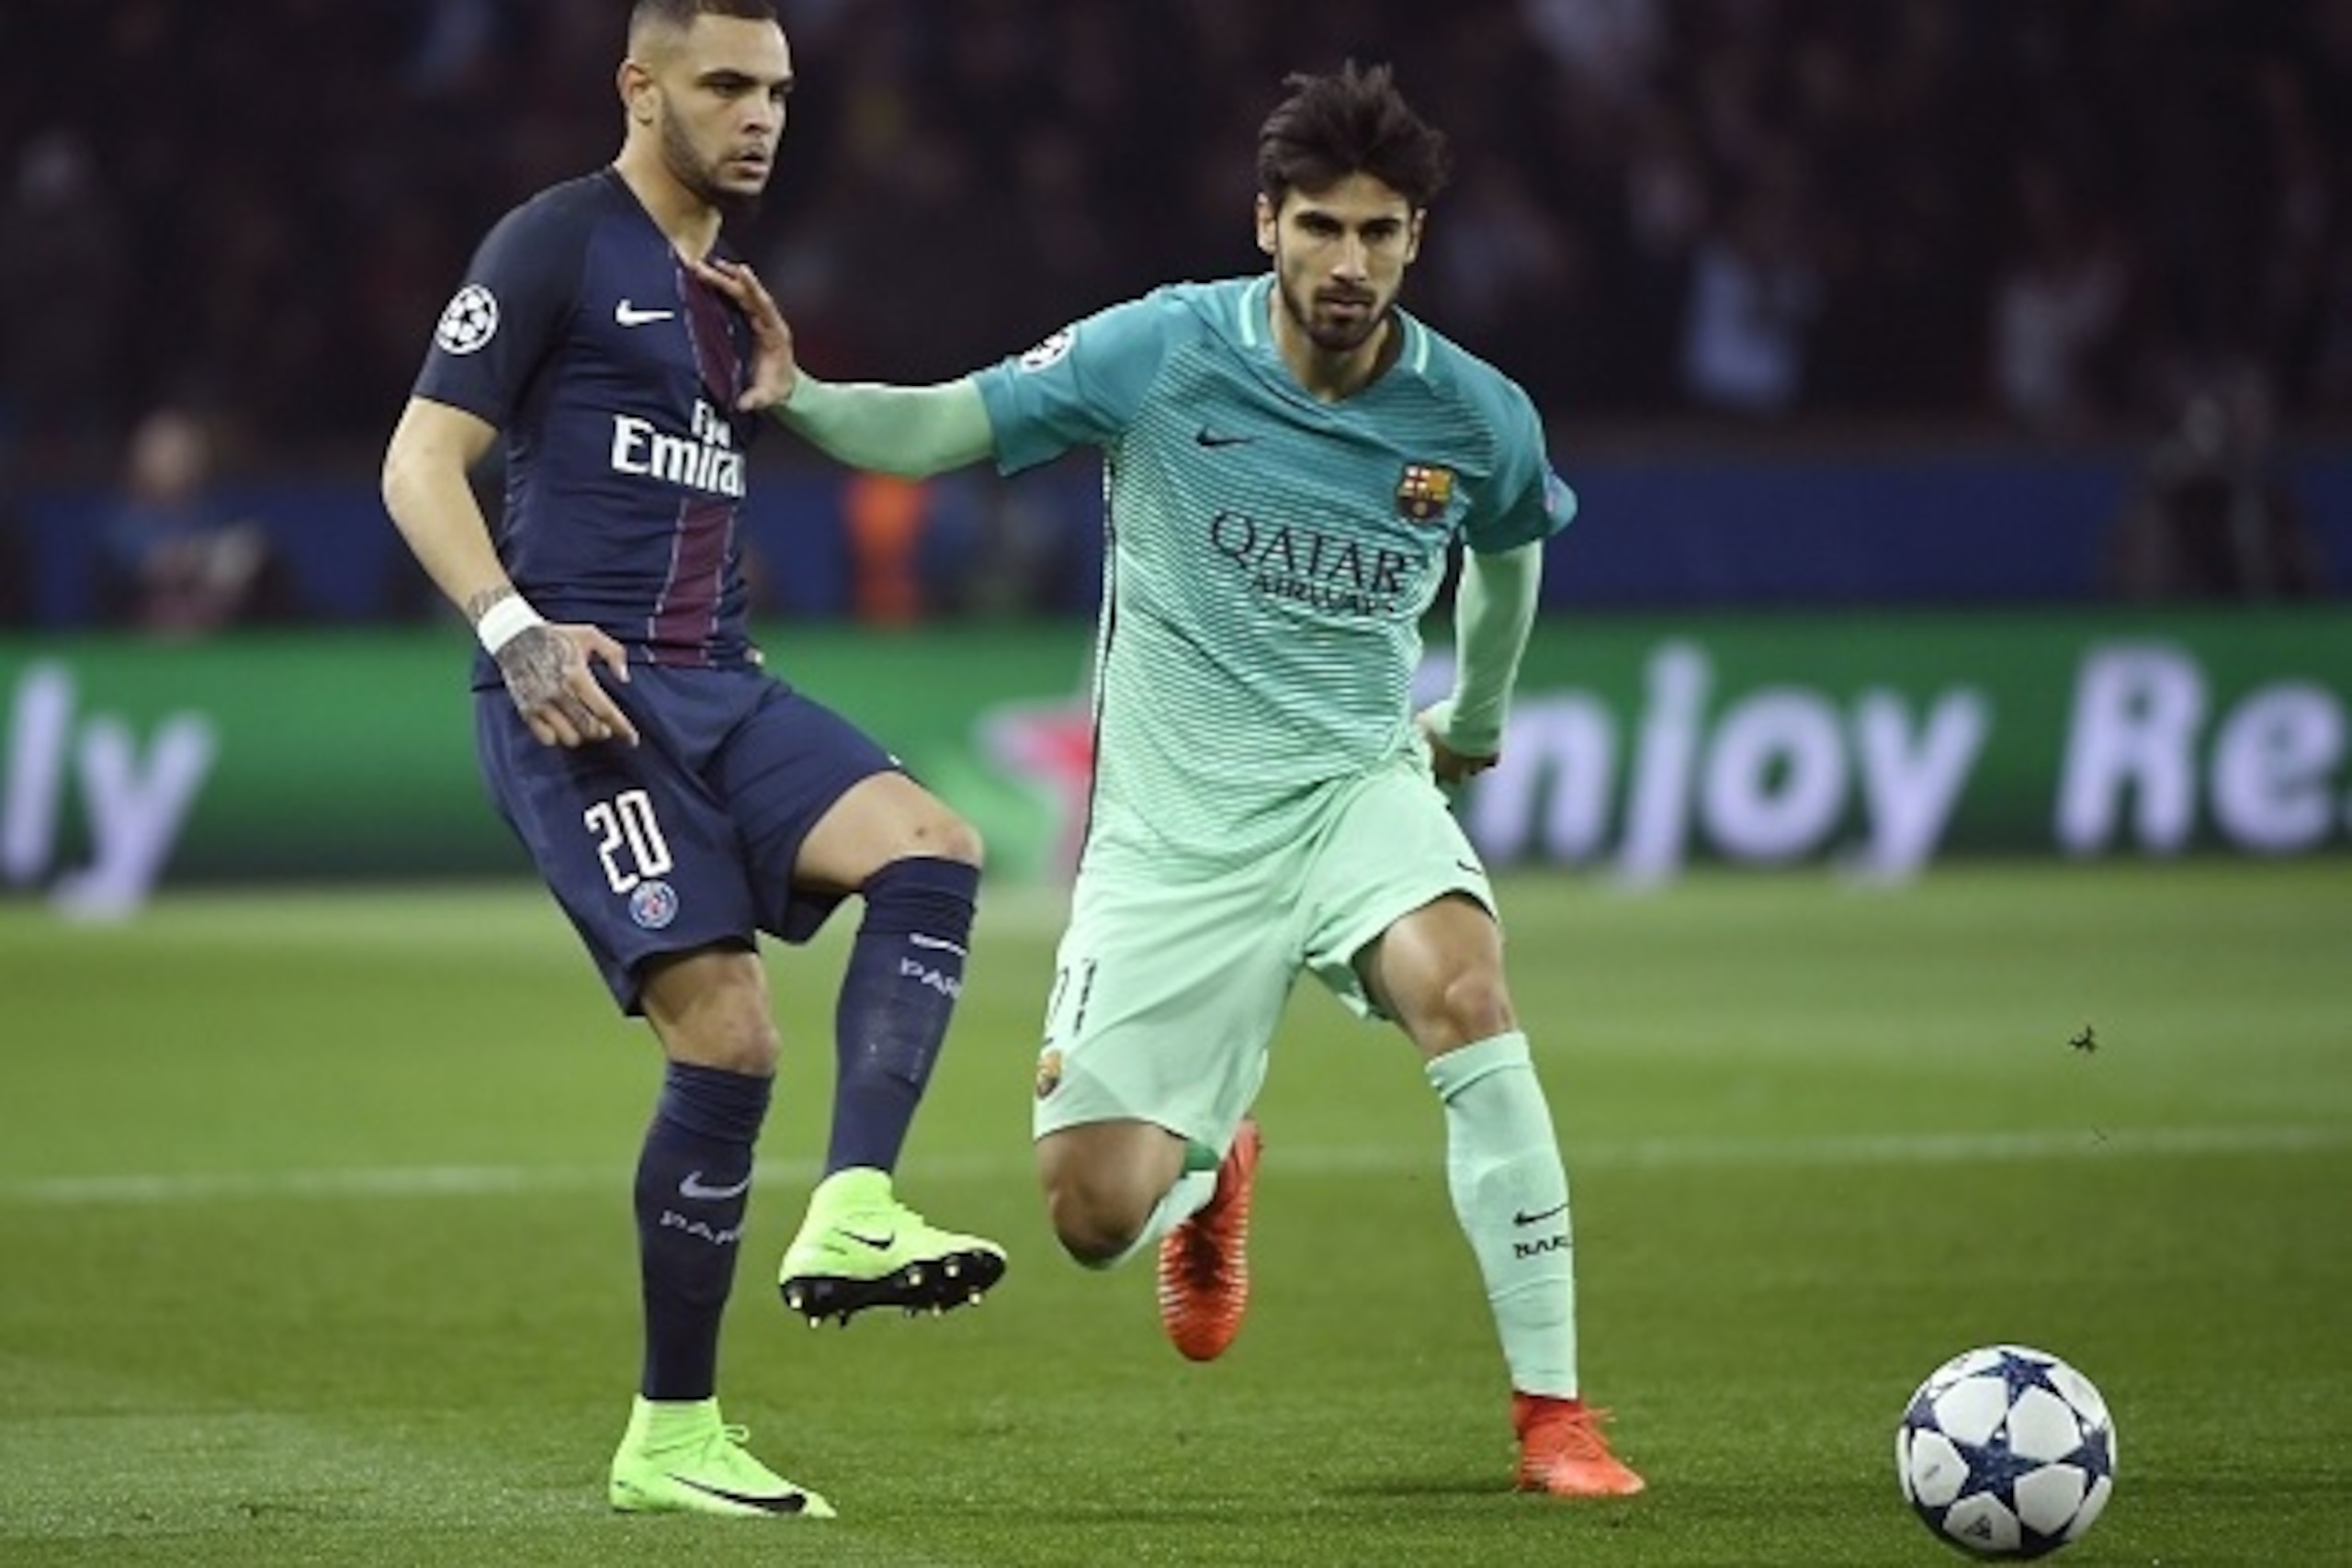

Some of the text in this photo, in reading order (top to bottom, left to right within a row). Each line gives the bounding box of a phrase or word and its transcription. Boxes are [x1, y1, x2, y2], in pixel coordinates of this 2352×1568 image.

[1211, 510, 1408, 593] QATAR
[1408, 641, 2352, 891] njoy Re
[583, 788, 673, 895] 20
